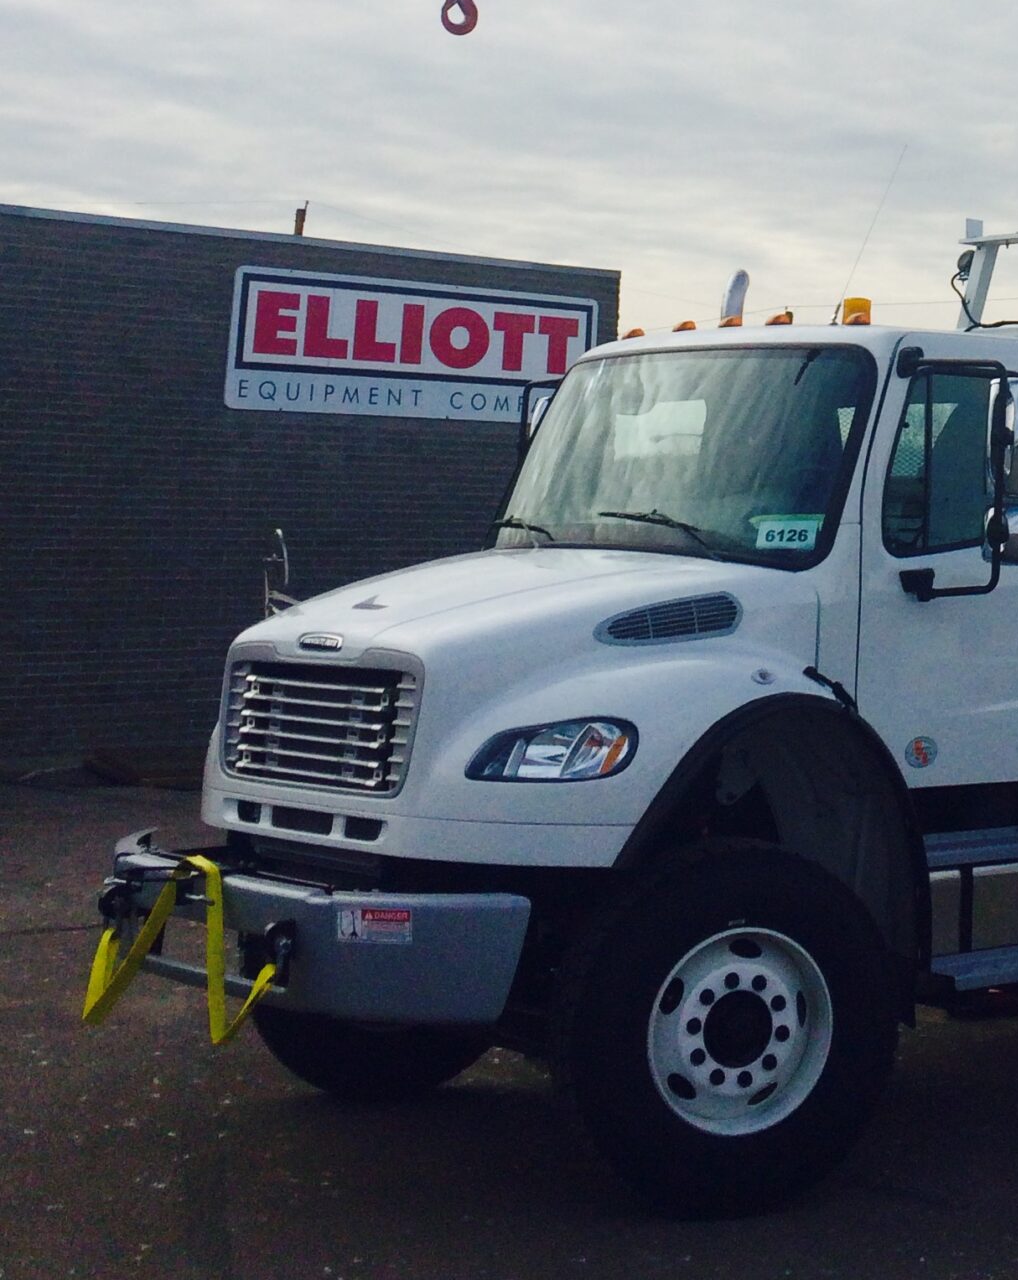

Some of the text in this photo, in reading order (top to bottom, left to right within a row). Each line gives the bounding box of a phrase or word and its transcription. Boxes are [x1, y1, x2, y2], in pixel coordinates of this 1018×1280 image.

[253, 291, 579, 374] ELLIOTT
[238, 379, 422, 407] EQUIPMENT
[765, 529, 808, 542] 6126
[374, 911, 409, 920] DANGER
